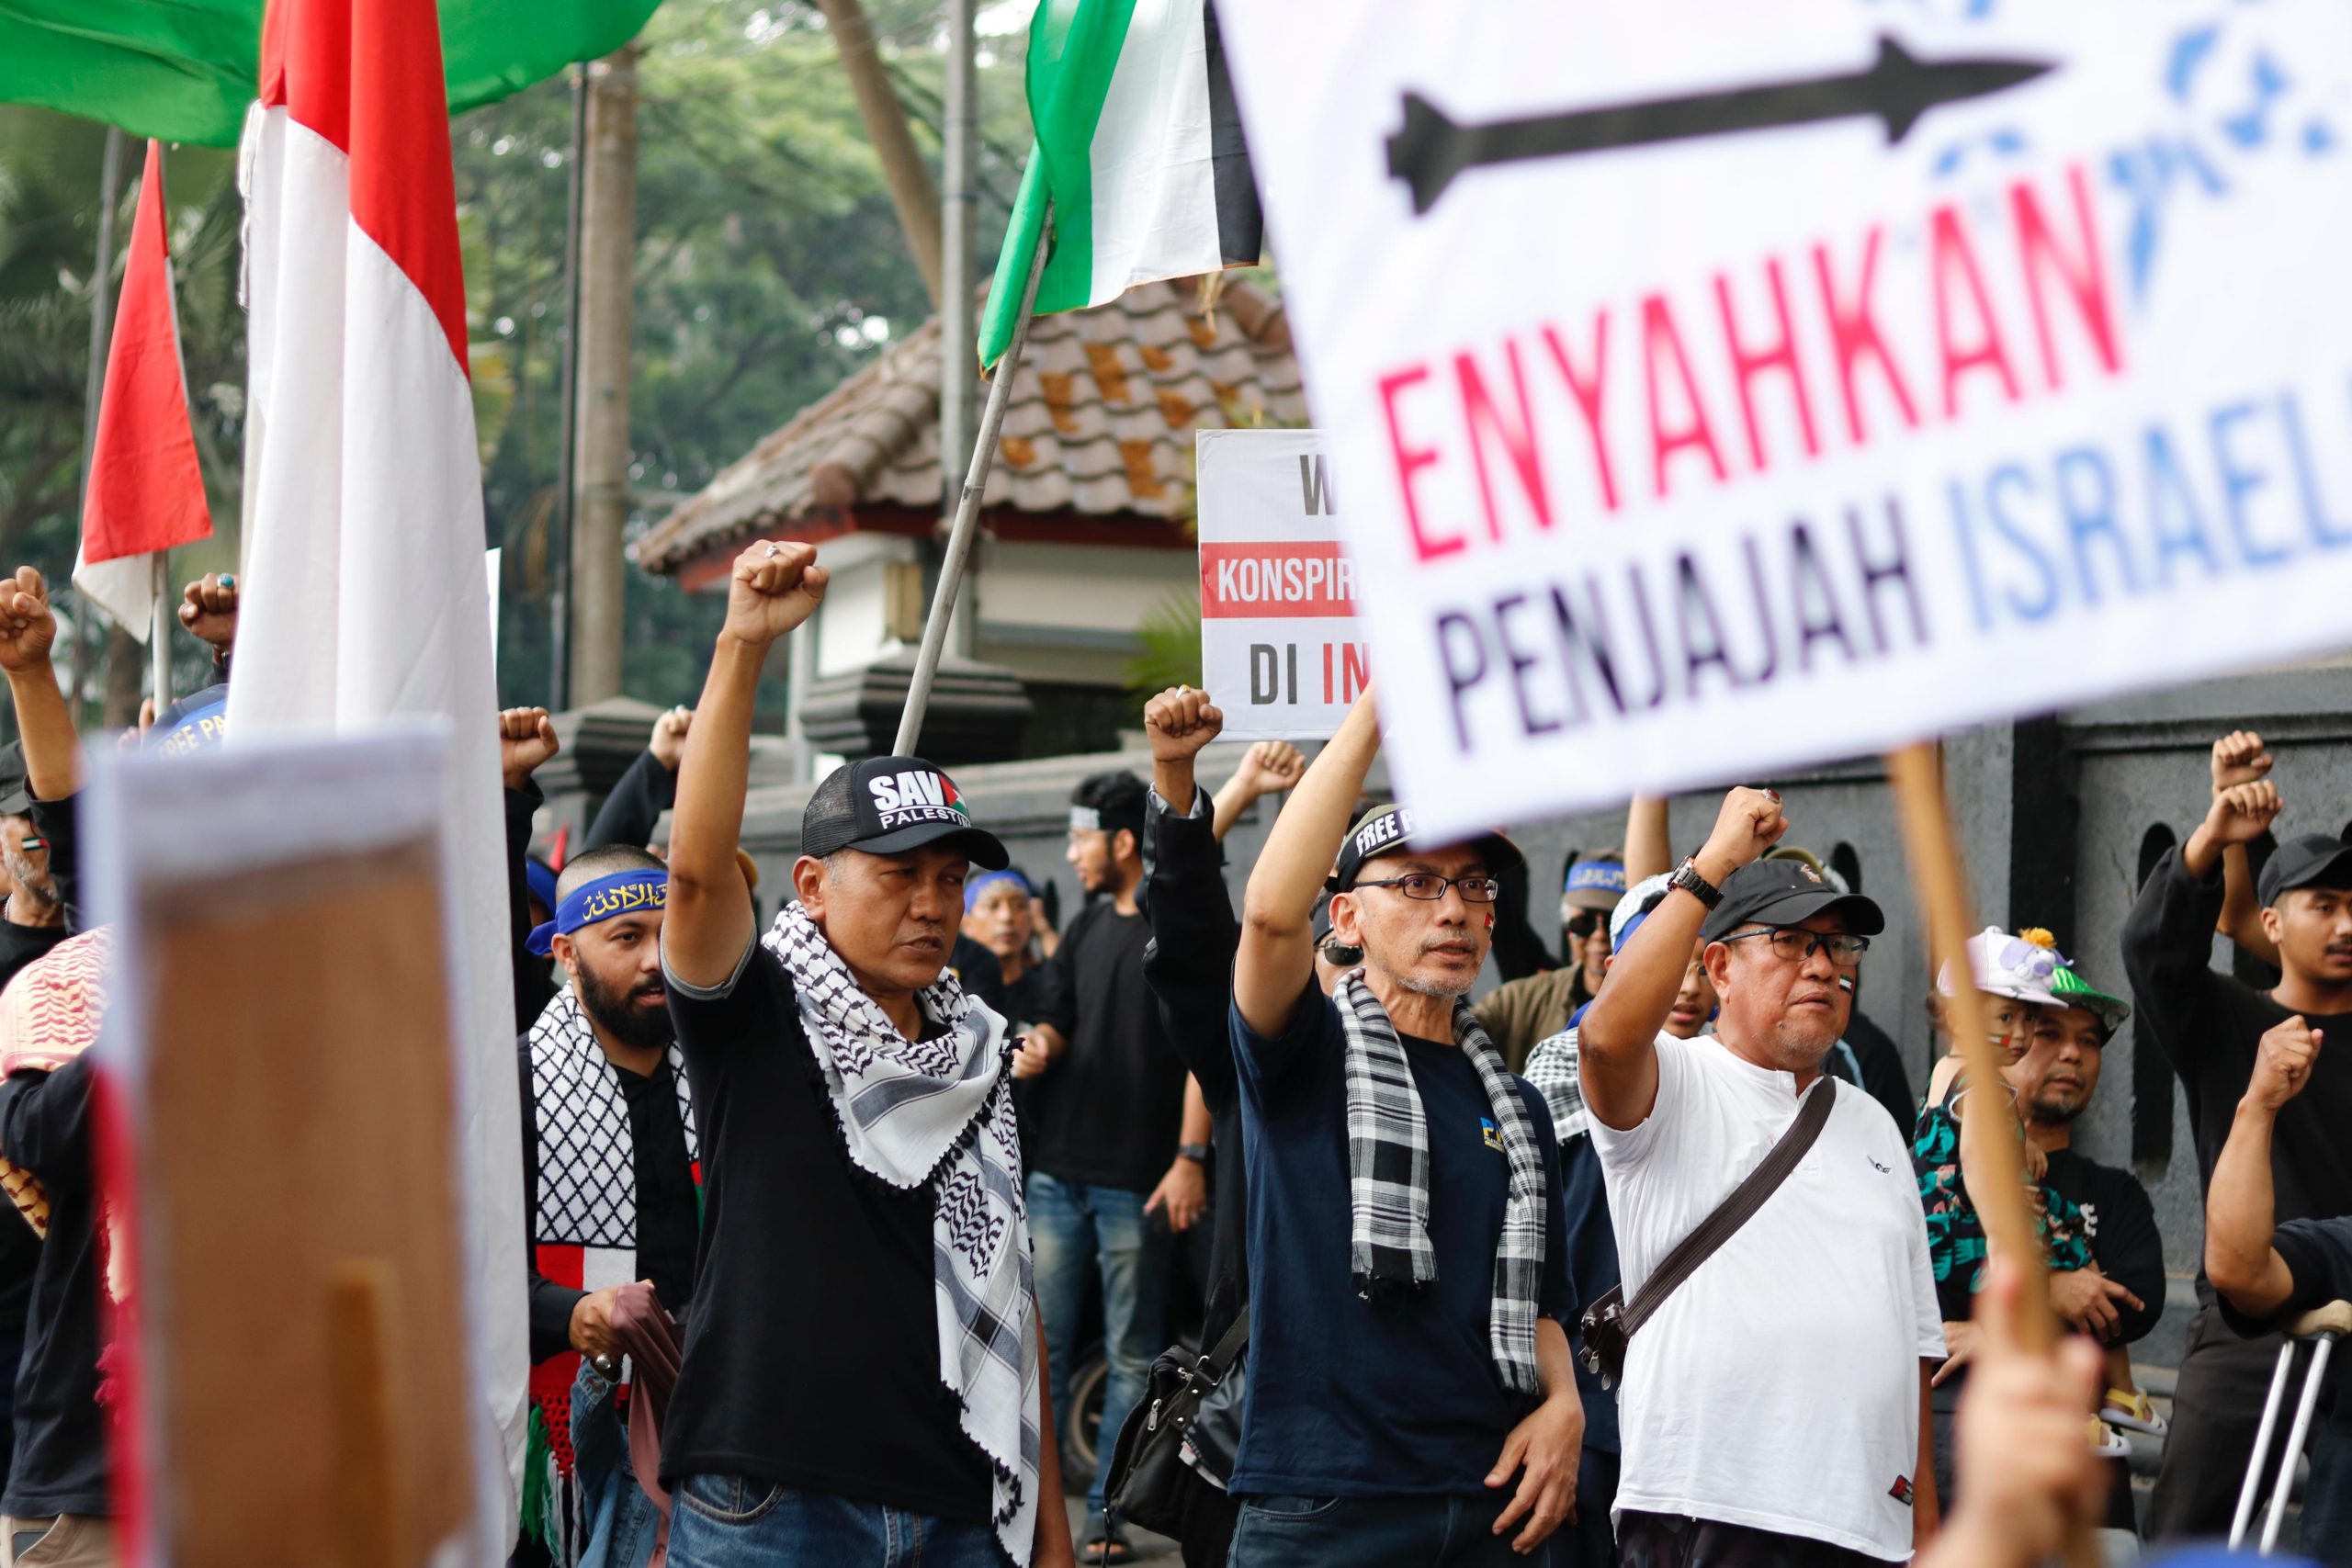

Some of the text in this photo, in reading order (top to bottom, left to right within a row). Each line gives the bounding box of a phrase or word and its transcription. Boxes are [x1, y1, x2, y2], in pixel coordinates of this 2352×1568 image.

[1377, 164, 2123, 563] ENYAHKAN
[1299, 454, 1338, 516] W
[1217, 558, 1359, 602] KONSPIR
[1434, 386, 2352, 753] PENJAJAH ISRAEL
[1250, 642, 1372, 705] DI IN
[157, 715, 226, 762] FREE PA
[880, 808, 972, 829] PALESTIN
[1356, 808, 1415, 858] FREE P
